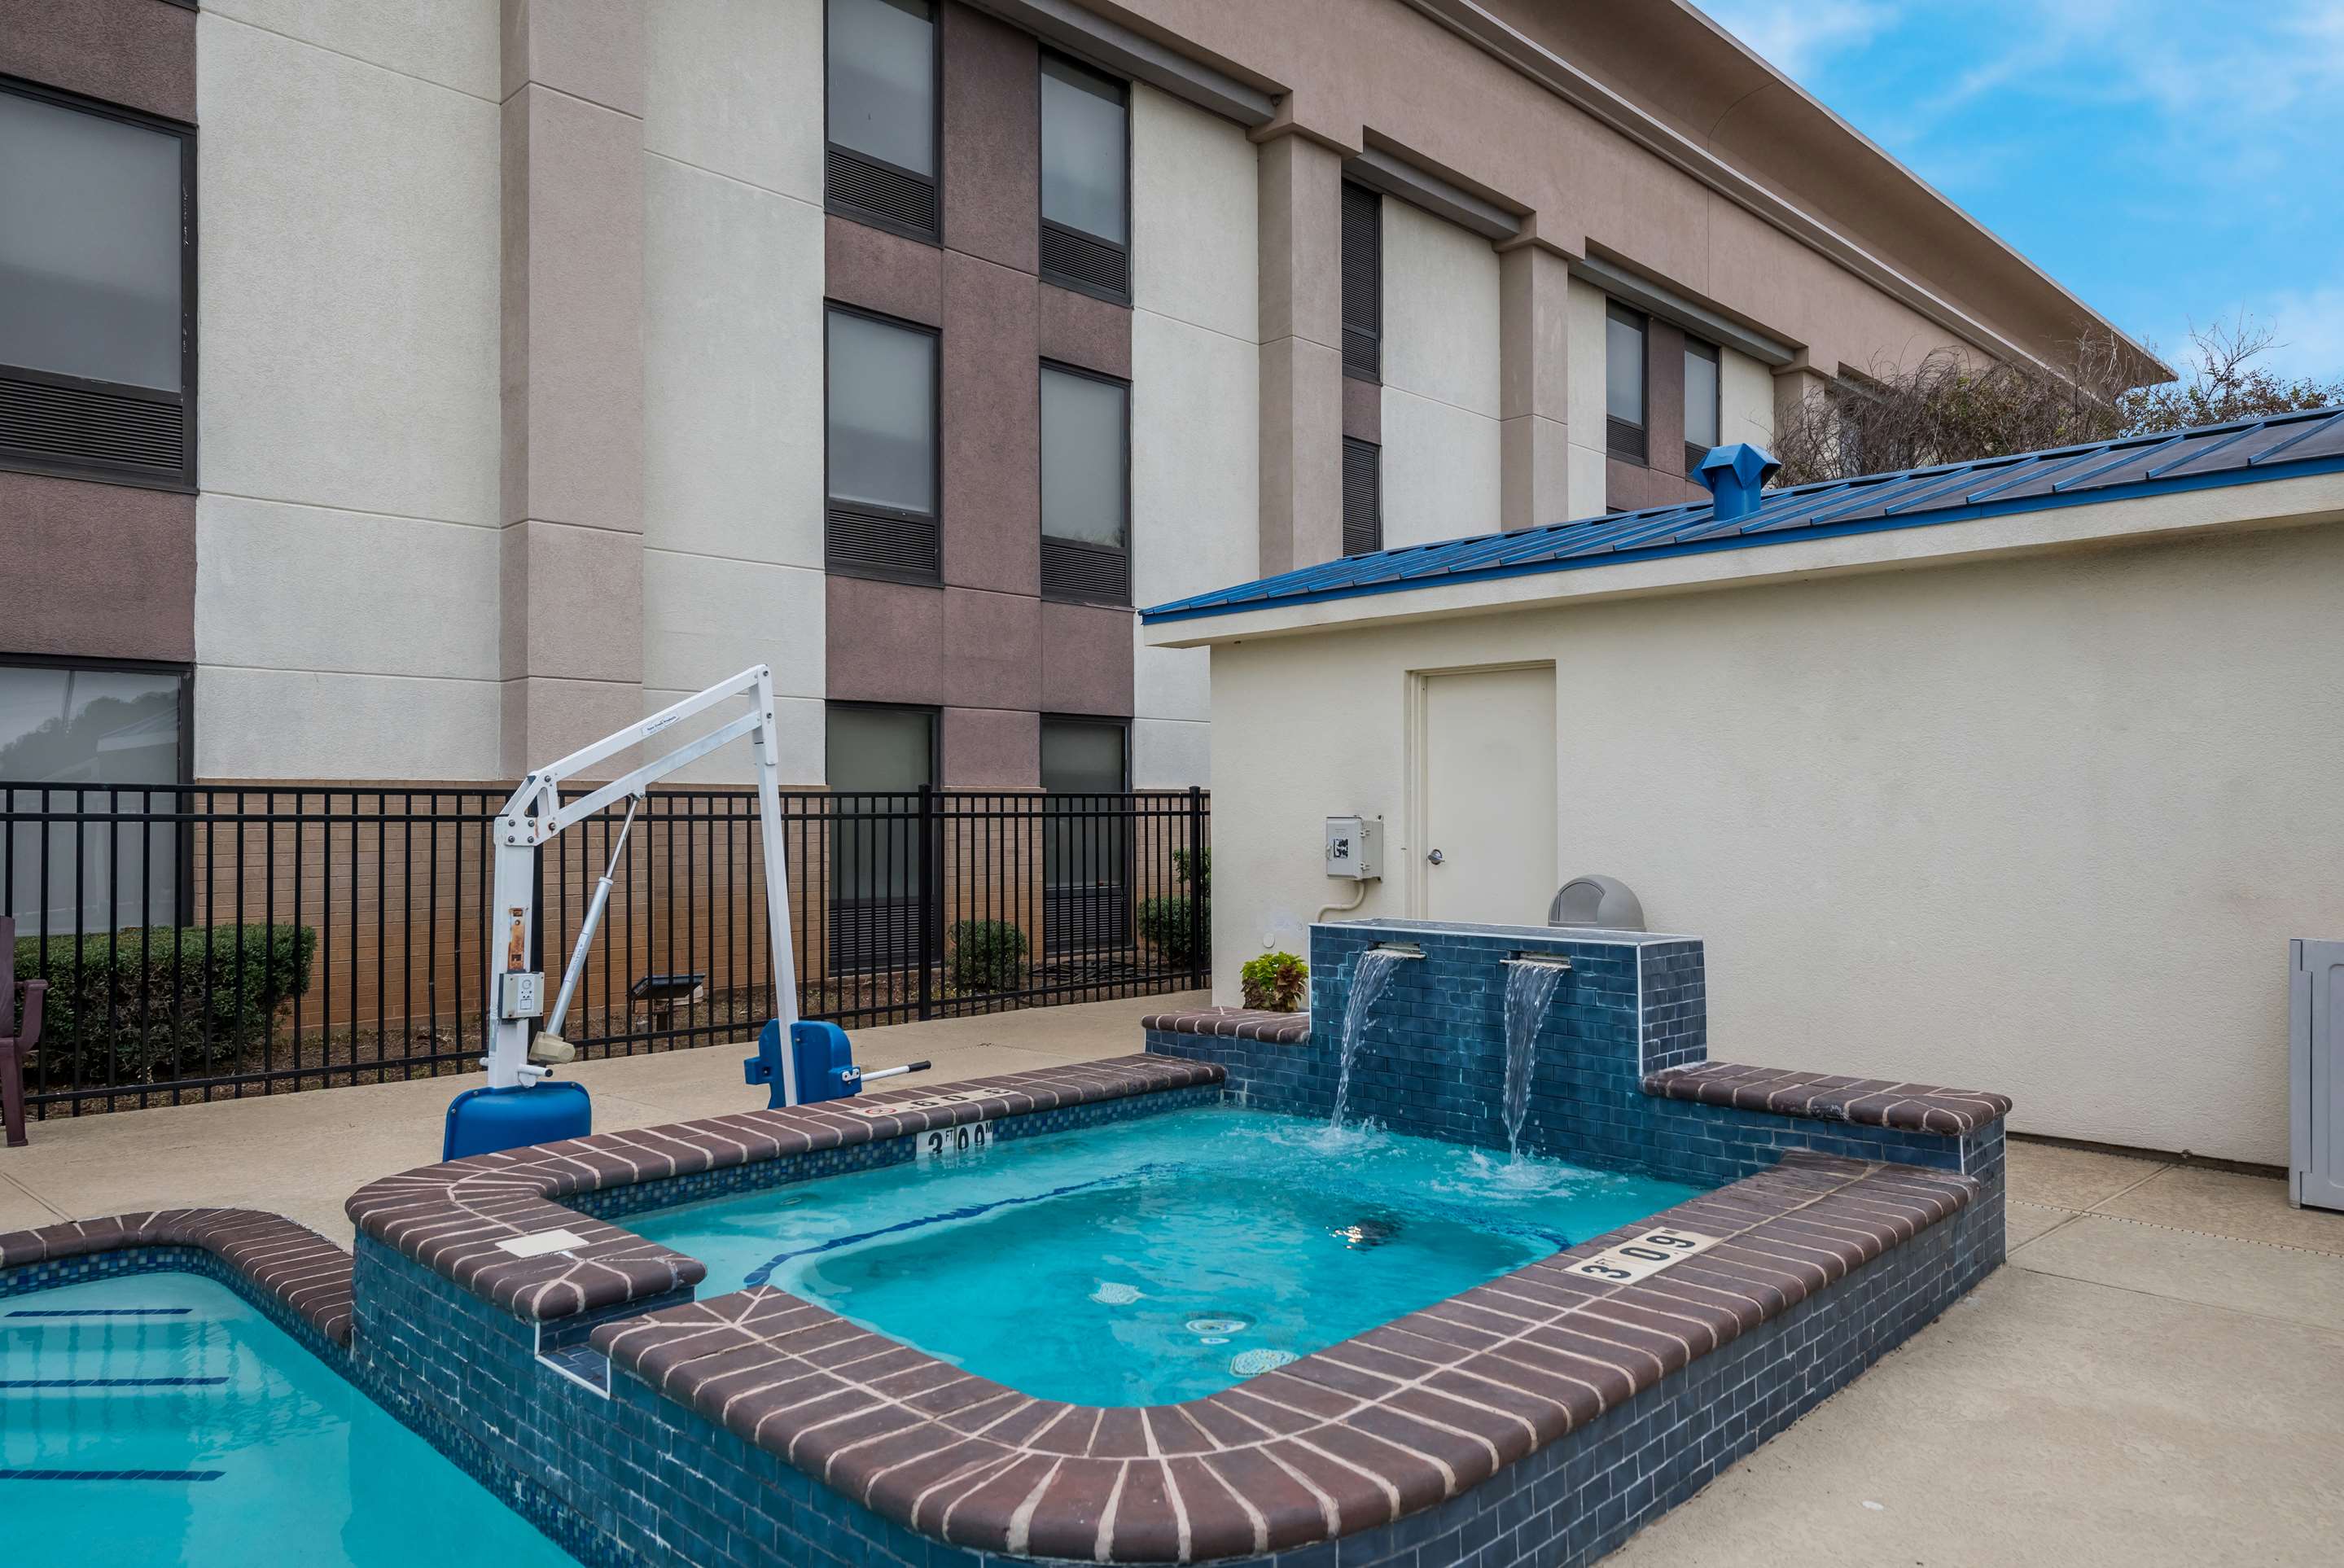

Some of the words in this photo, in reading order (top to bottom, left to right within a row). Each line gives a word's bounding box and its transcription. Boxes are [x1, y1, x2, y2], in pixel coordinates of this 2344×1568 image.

[945, 1129, 953, 1141] FT
[986, 1123, 992, 1133] M
[1581, 1265, 1632, 1278] 3
